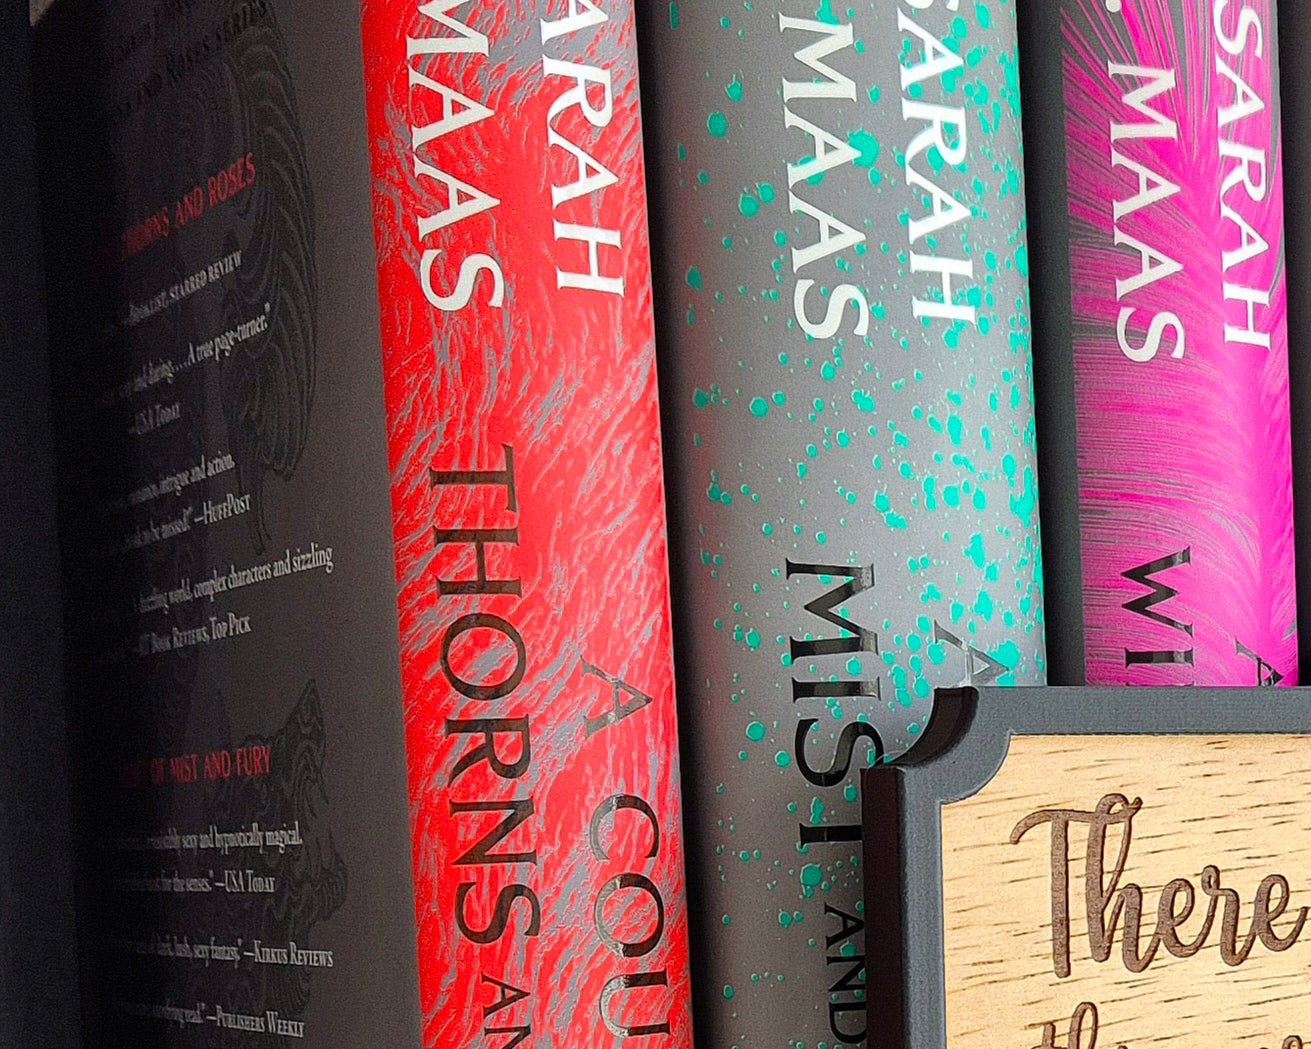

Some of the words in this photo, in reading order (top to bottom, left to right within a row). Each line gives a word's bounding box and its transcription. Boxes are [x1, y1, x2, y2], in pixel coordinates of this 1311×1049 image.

[208, 151, 256, 208] ROSES
[406, 0, 502, 312] MAAS
[778, 12, 870, 341] MAAS
[897, 0, 977, 327] ARAH
[1106, 58, 1187, 363] MAAS
[1213, 0, 1272, 351] SARAH
[208, 250, 243, 284] REVIEW
[193, 569, 228, 602] complex
[228, 564, 272, 591] characters
[273, 548, 292, 578] and
[292, 542, 334, 574] sizzling
[1121, 545, 1196, 686] WI
[203, 749, 232, 782] AND
[235, 744, 271, 779] FURY
[428, 443, 541, 947] THORNS
[580, 651, 654, 743] A
[289, 941, 334, 968] REVIEWS
[1010, 791, 1308, 978] There
[266, 1010, 305, 1038] WEEKLY
